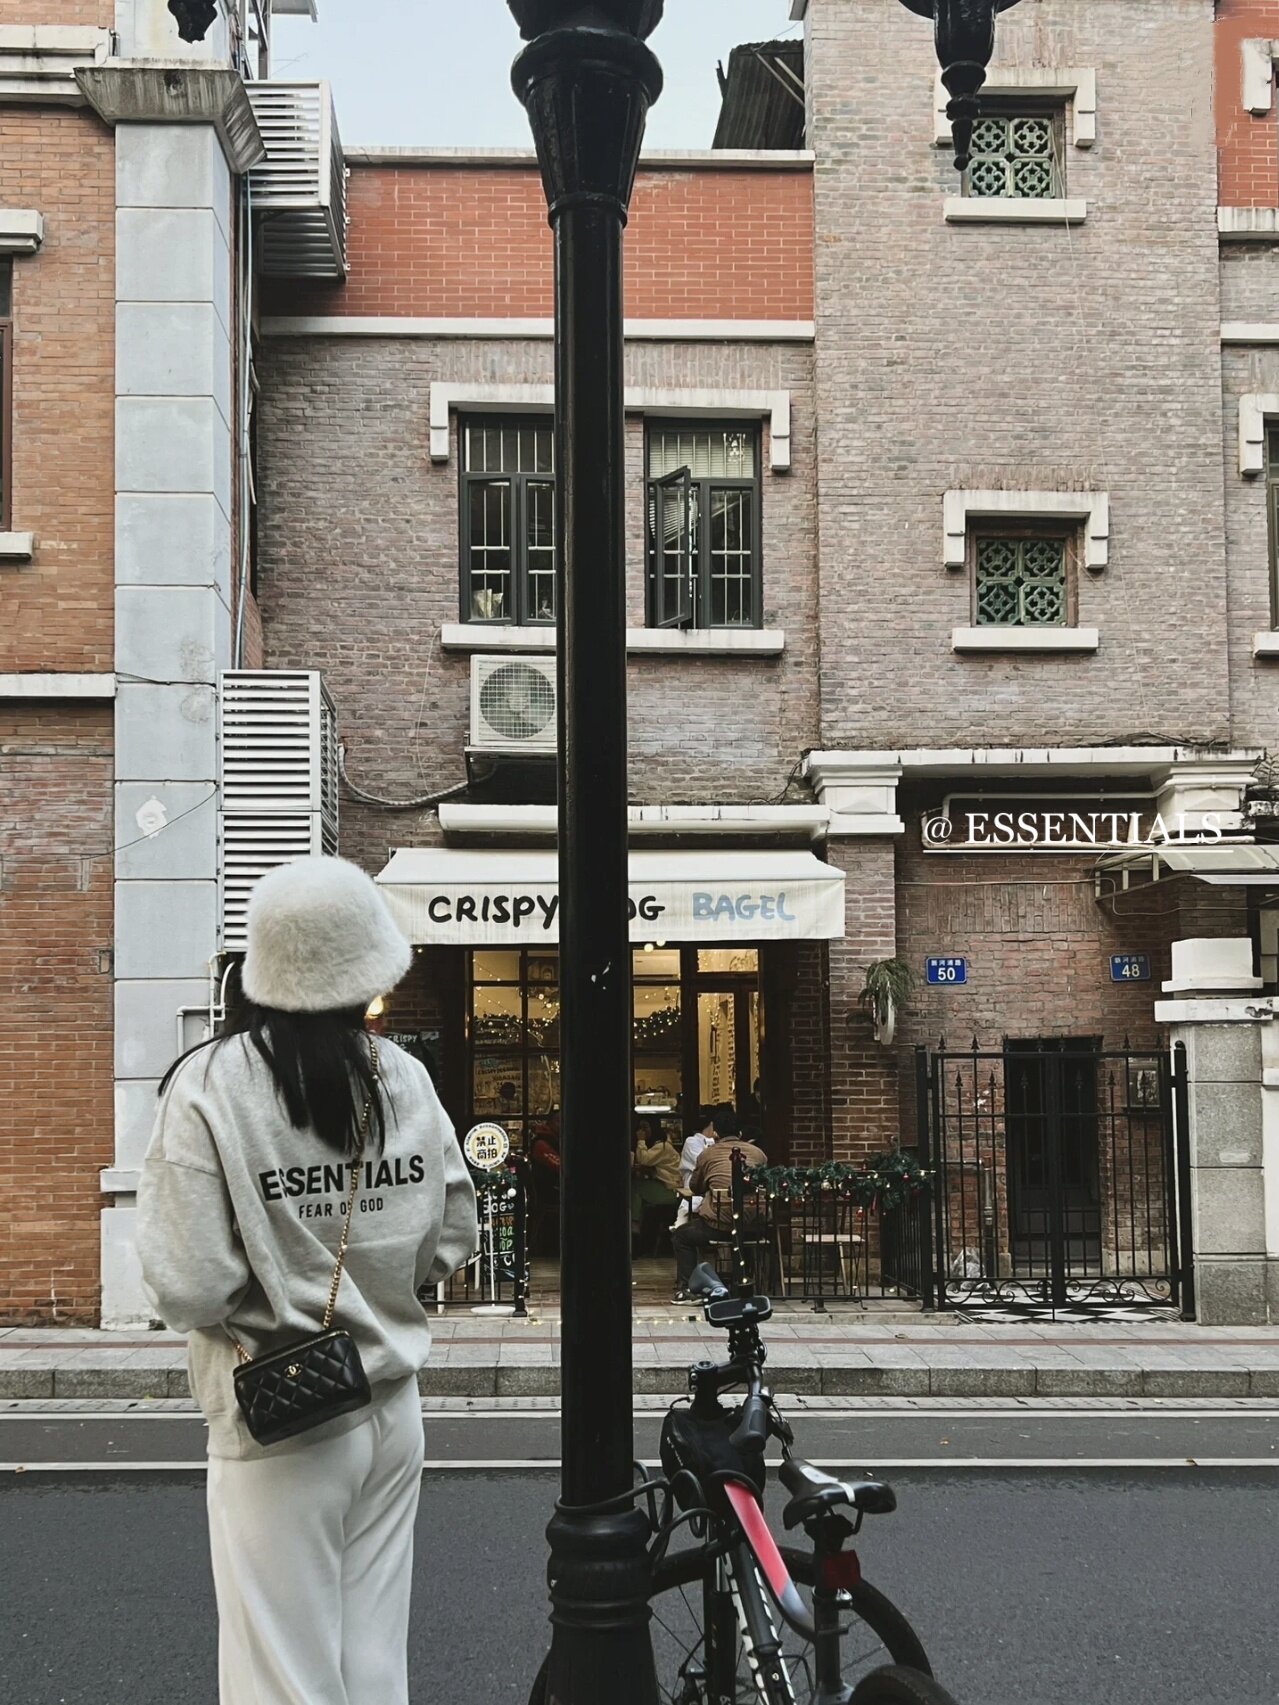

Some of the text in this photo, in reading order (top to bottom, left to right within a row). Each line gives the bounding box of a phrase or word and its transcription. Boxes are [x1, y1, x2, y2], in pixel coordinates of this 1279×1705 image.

[428, 895, 559, 930] CRISPY
[692, 892, 796, 921] BAGEL
[937, 967, 956, 981] 50
[1121, 963, 1140, 977] 48
[298, 1202, 333, 1219] FEAR
[360, 1197, 384, 1213] GOD
